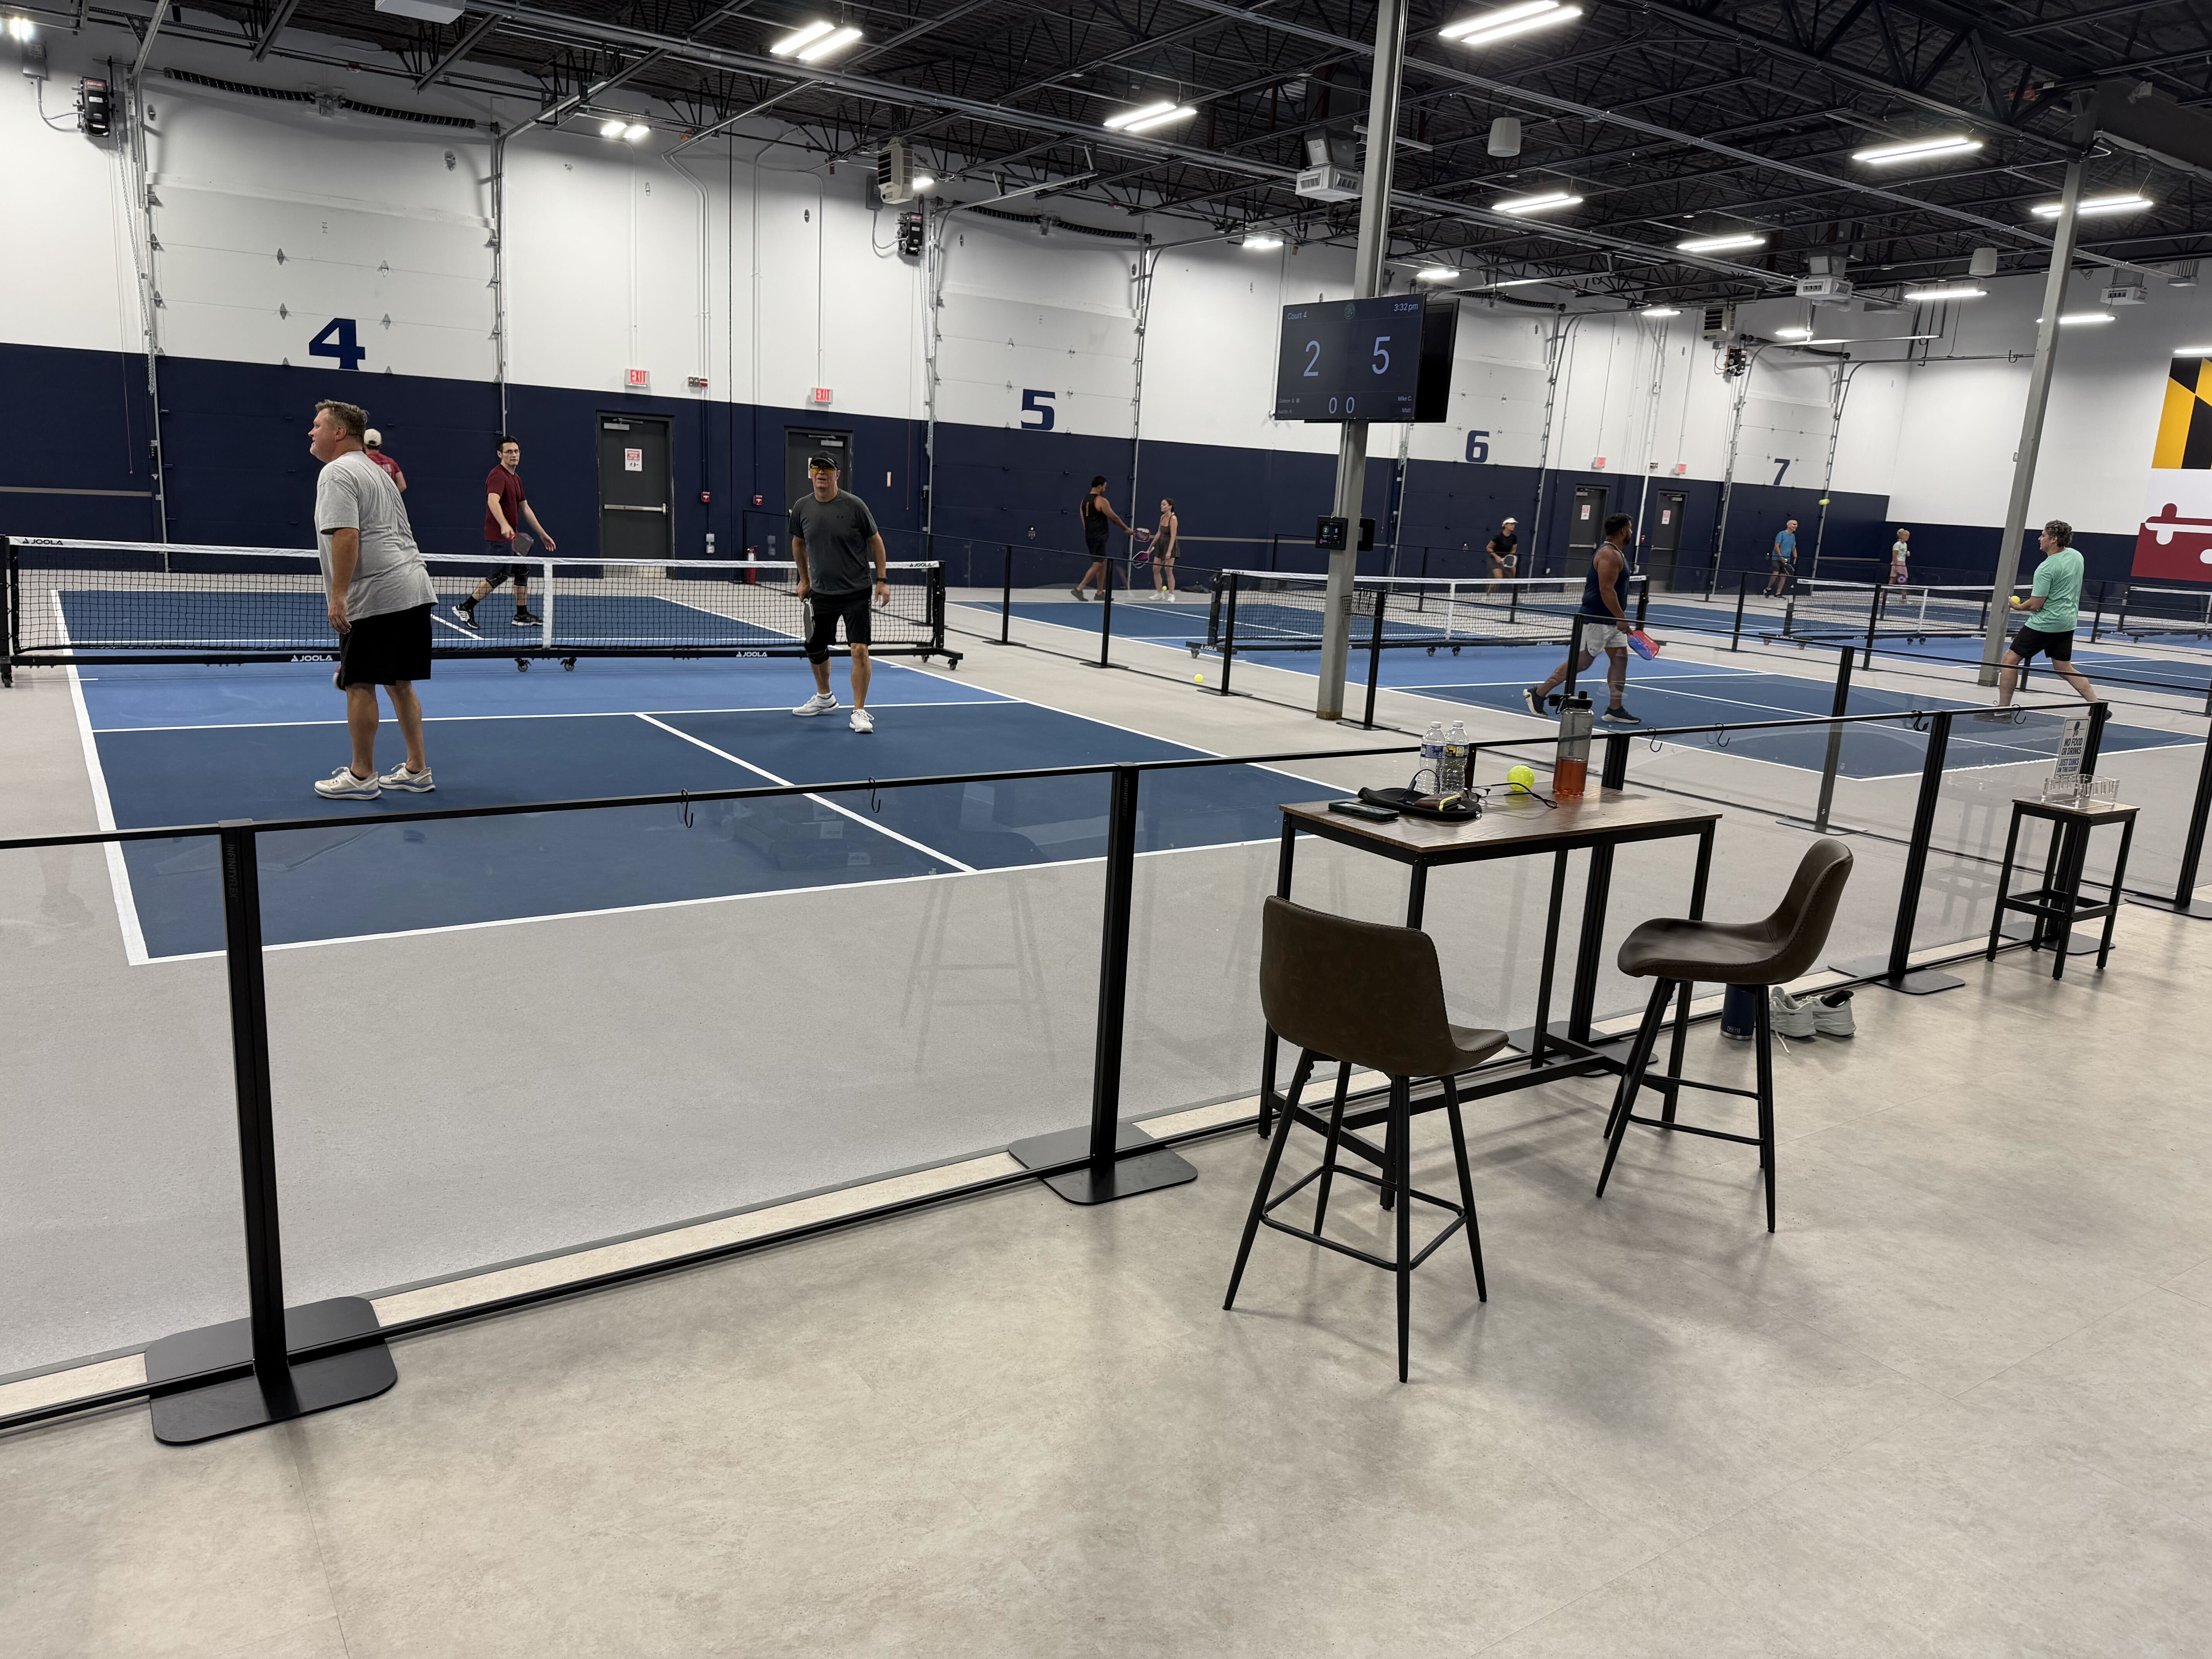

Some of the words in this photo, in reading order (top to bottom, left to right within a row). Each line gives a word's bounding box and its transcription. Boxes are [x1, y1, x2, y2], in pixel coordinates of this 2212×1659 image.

[309, 318, 366, 371] 4
[1372, 336, 1390, 374] 5
[1304, 340, 1320, 376] 2
[630, 369, 647, 384] EXIT
[816, 388, 831, 402] EXIT
[1329, 397, 1338, 414] 0
[1346, 397, 1355, 414] 0
[1021, 388, 1056, 431] 5
[1465, 430, 1490, 463] 6
[1774, 459, 1790, 485] 7
[2061, 747, 2067, 756] OR
[2067, 747, 2082, 755] DRINKS
[2064, 738, 2071, 747] NO
[2071, 737, 2083, 746] FOOD
[2069, 757, 2080, 766] DINKS
